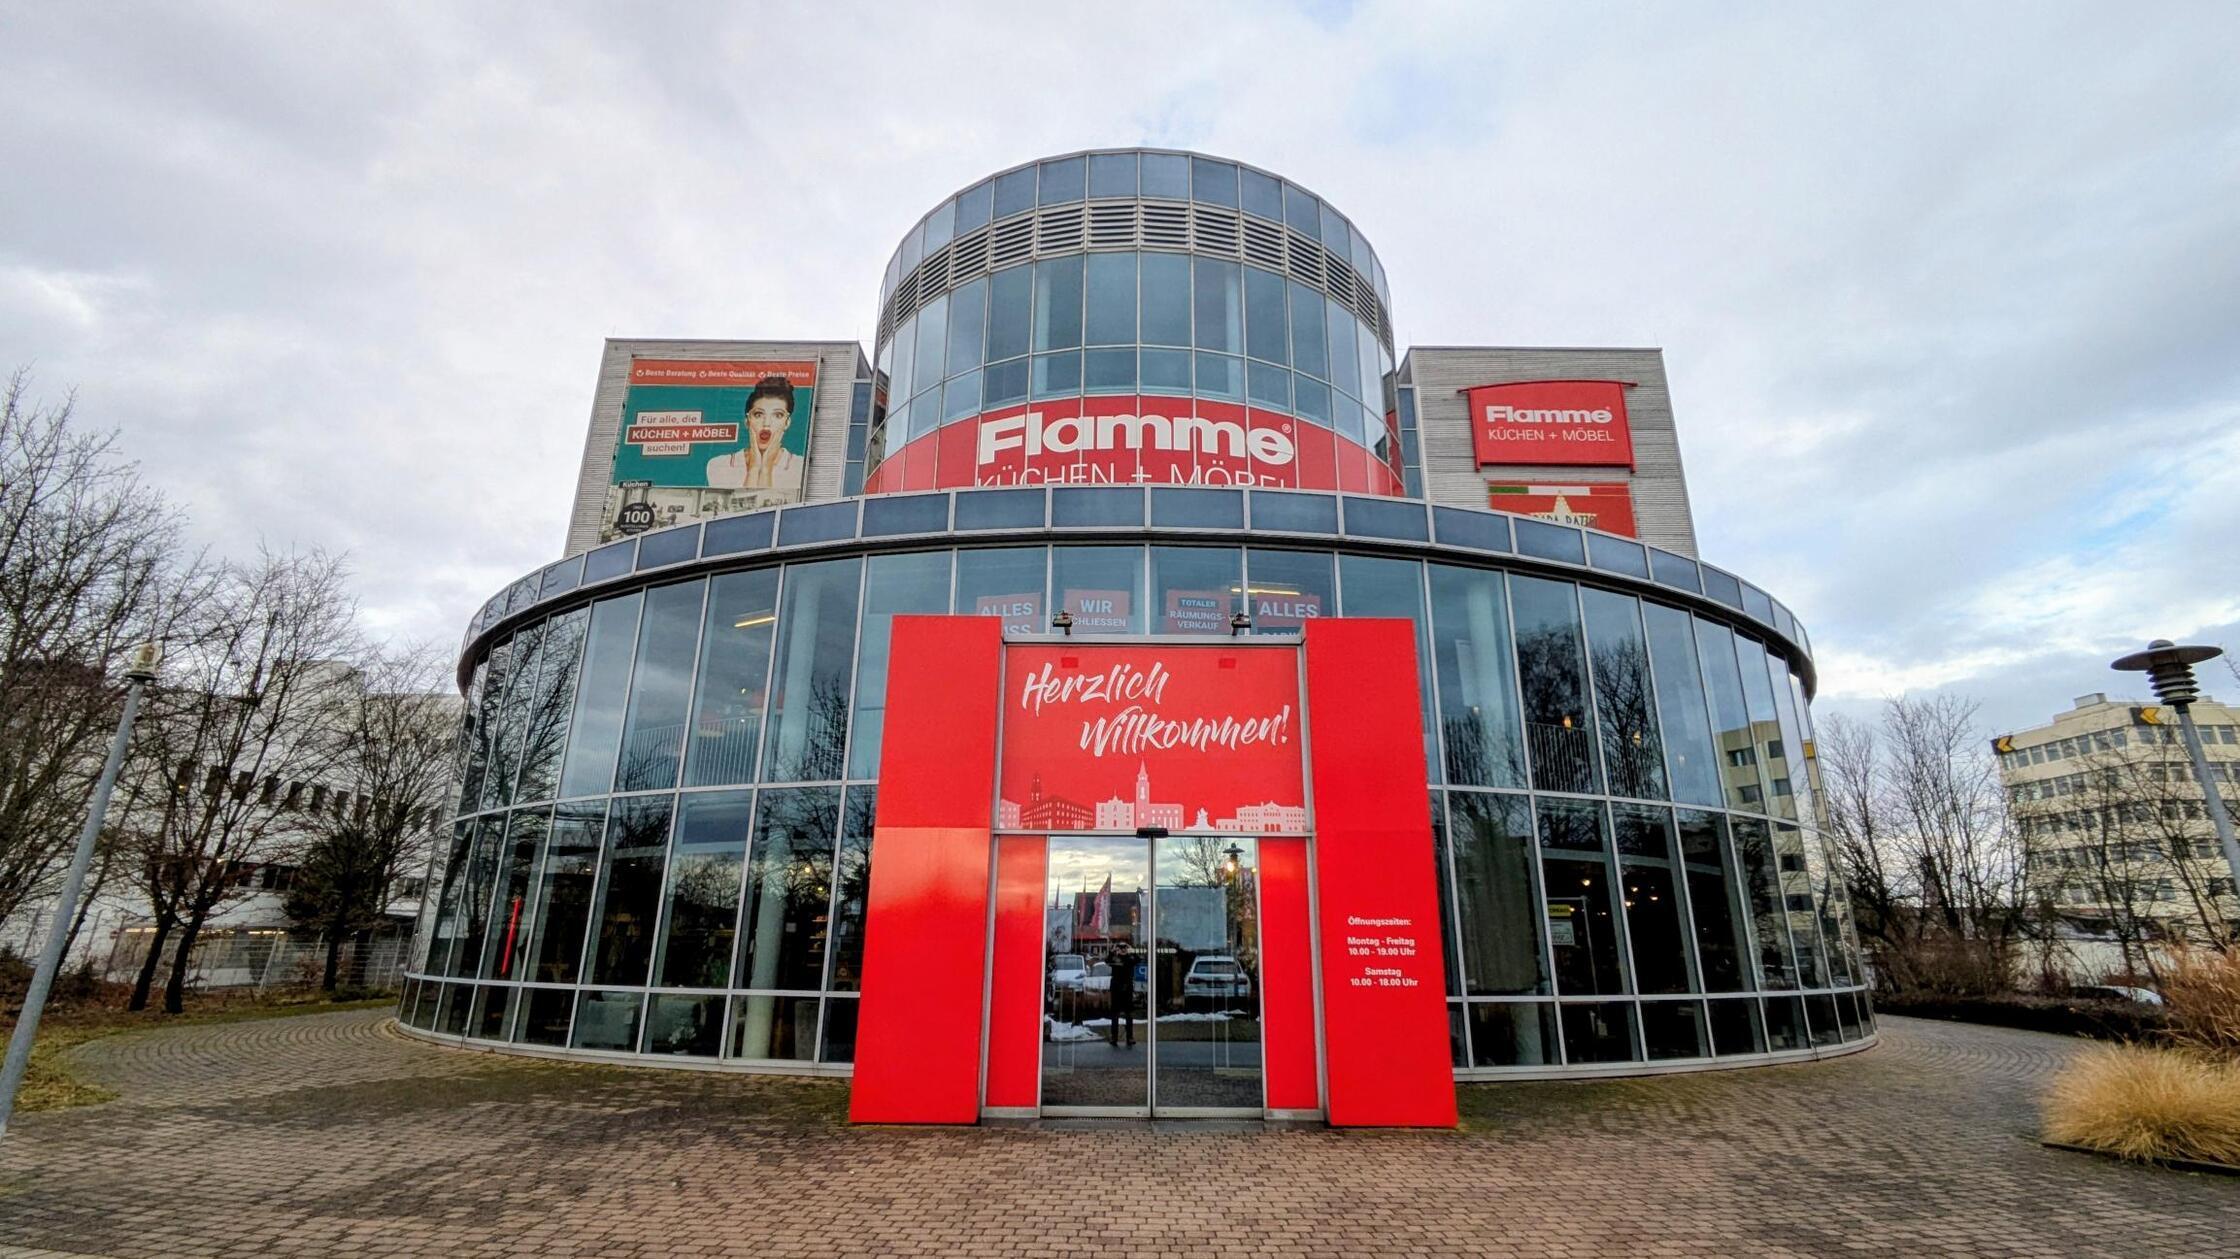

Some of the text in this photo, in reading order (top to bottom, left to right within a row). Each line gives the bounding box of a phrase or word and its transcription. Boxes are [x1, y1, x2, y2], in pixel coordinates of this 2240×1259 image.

[641, 415, 697, 425] Für alle, die
[1486, 406, 1613, 424] Flamme
[632, 428, 680, 440] KÜCHEN
[692, 426, 732, 438] MÖBEL
[979, 412, 1295, 465] Flamme
[1488, 427, 1545, 441] KÜCHEN
[1562, 427, 1615, 442] MÖBEL
[647, 443, 686, 453] suchen!
[623, 511, 650, 524] 100
[981, 602, 1033, 617] ALLES
[1080, 600, 1112, 614] WIR
[1181, 599, 1216, 608] TOTALER
[1259, 601, 1318, 618] ALLES
[1072, 617, 1127, 627] CHLIESSEN
[1177, 620, 1219, 631] VERKAUF
[1021, 662, 1170, 717] Herzlich
[1079, 704, 1291, 757] Willkommen!
[1347, 916, 1412, 927] Öffnungszeiten:
[1347, 936, 1380, 946] Montag
[1386, 937, 1415, 946] Freitag
[1365, 967, 1402, 977] Samstag
[1350, 978, 1372, 986] 10.00
[1379, 978, 1401, 986] 18.00
[1402, 978, 1418, 986] Uhr
